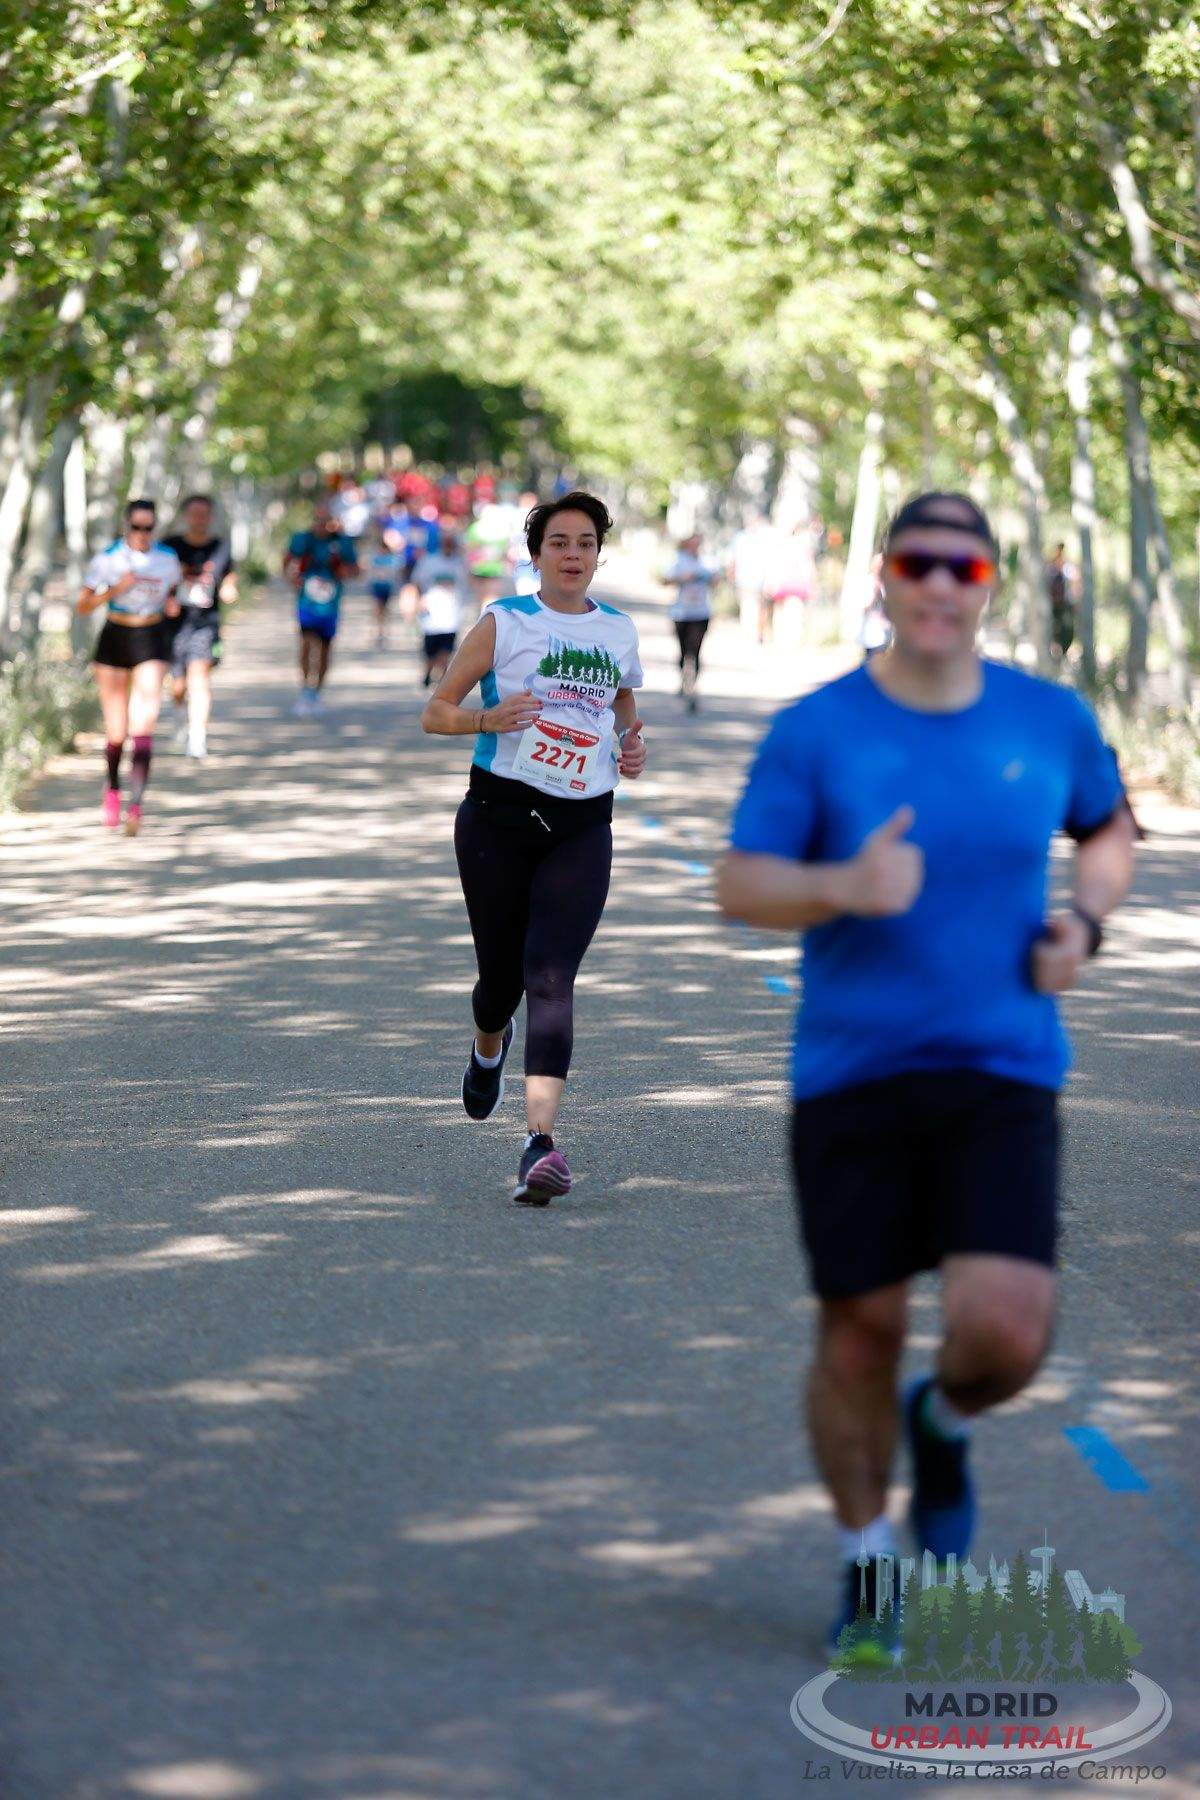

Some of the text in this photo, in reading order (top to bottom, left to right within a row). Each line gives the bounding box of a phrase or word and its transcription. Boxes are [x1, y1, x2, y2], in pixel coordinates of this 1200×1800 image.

[547, 691, 585, 700] URBAN
[560, 683, 605, 698] MADRID
[531, 741, 587, 775] 2271
